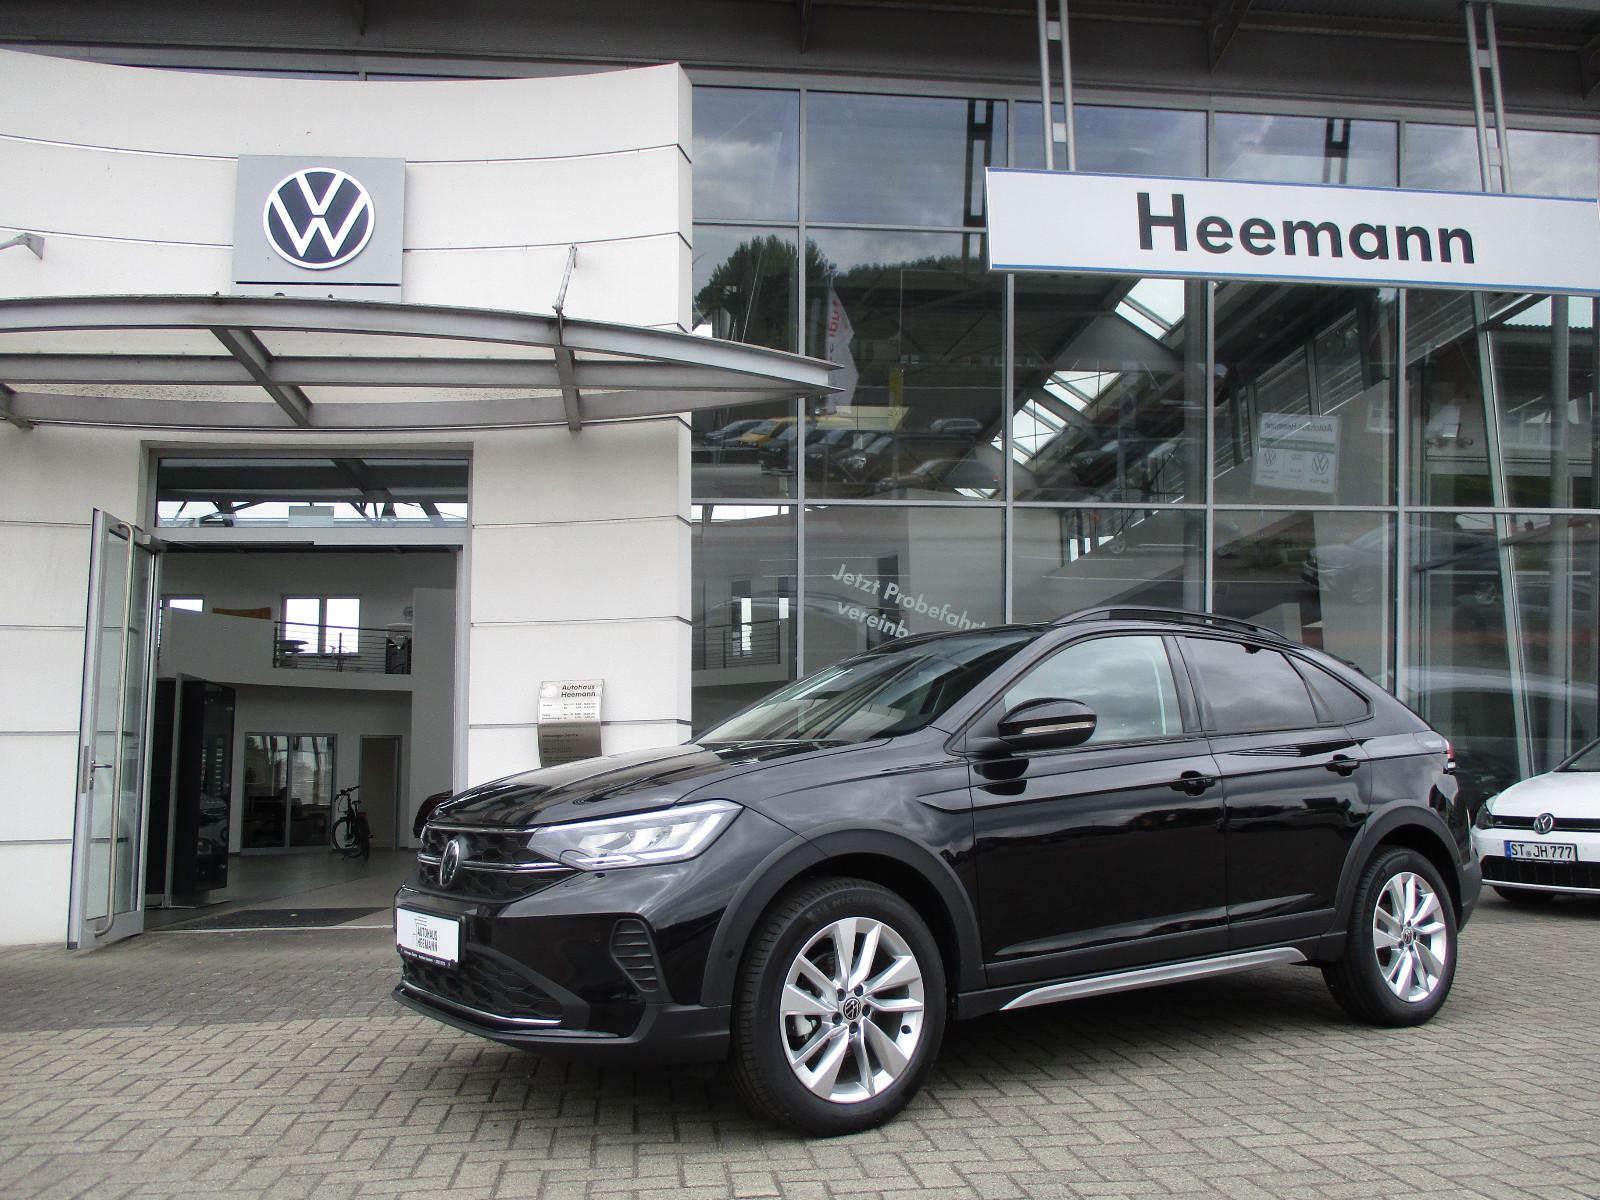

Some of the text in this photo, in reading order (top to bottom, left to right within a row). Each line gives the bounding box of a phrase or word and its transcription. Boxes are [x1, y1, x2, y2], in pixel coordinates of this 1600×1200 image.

[1136, 191, 1475, 265] Heemann
[832, 563, 880, 595] Jetzt
[837, 602, 912, 638] vereinb
[1511, 843, 1572, 859] ST JH 777
